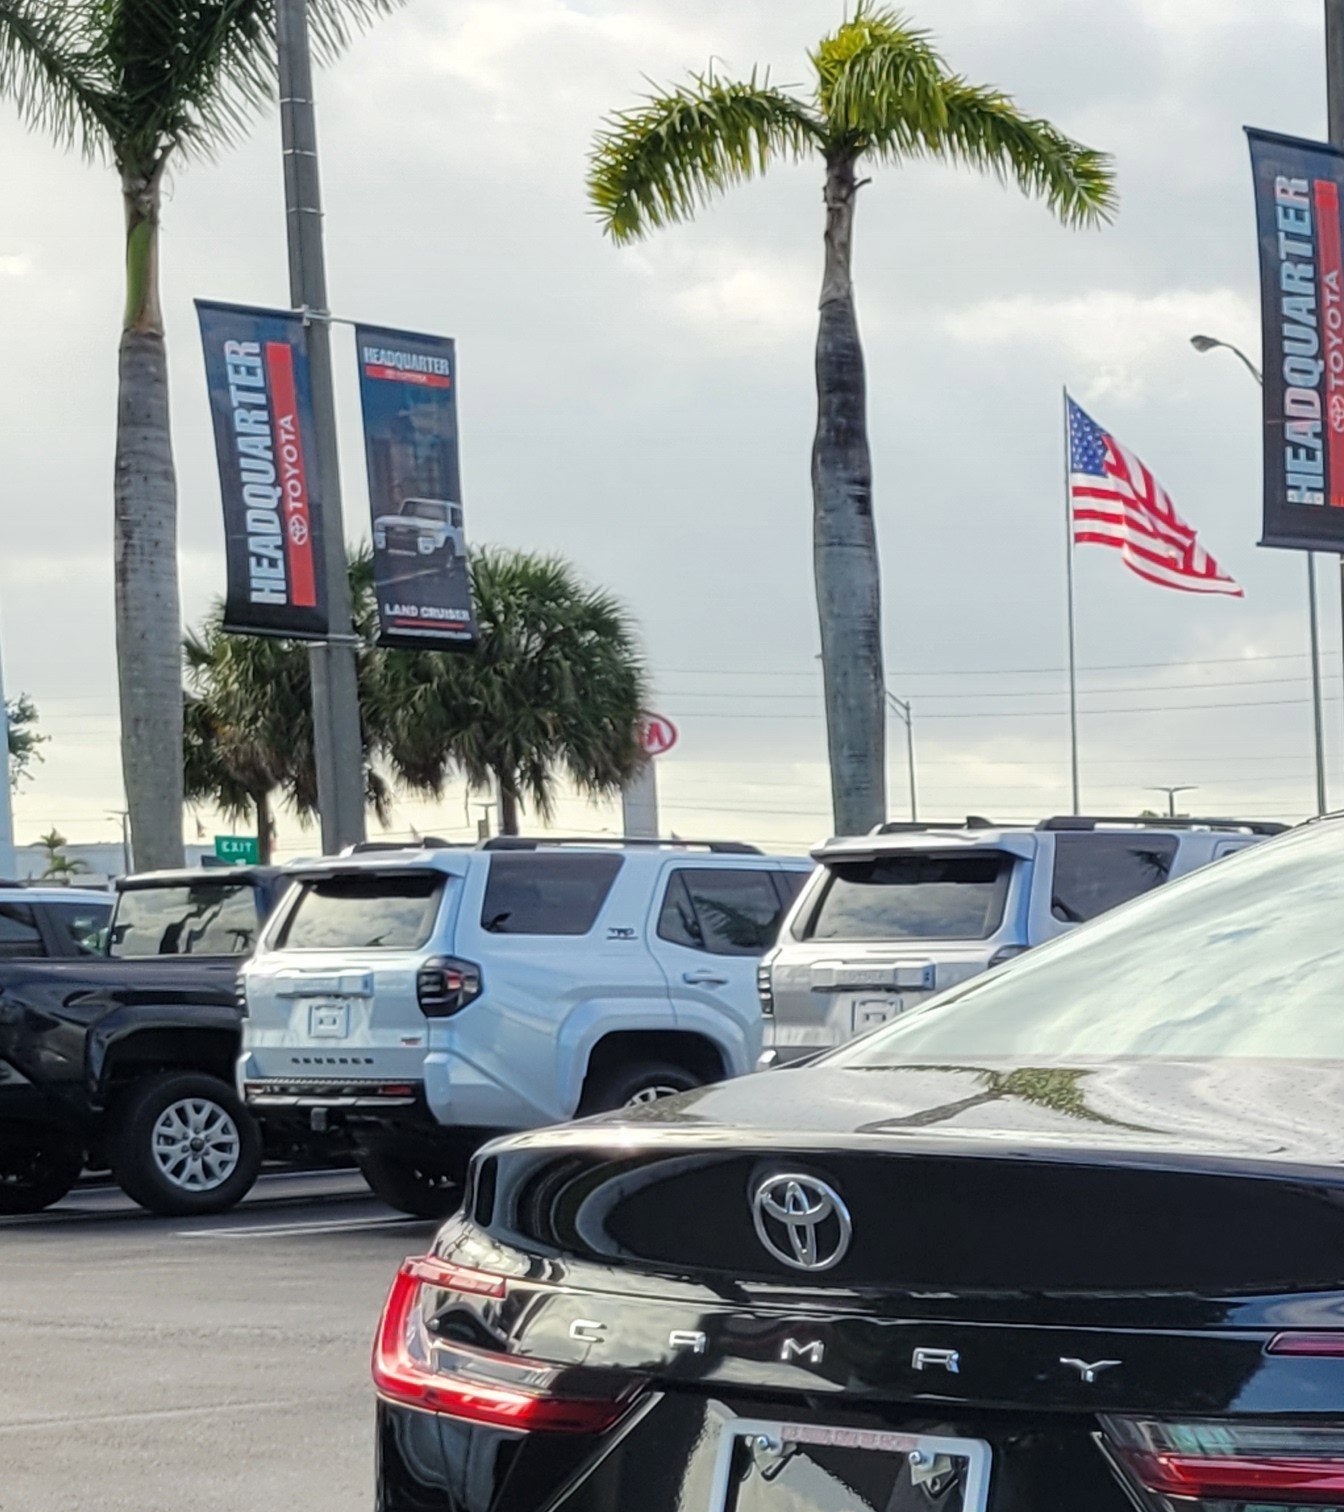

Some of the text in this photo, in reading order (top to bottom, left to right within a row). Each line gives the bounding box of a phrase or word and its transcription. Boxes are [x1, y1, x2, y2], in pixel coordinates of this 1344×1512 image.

[363, 346, 450, 376] HEADQUARTER
[1275, 175, 1325, 506] HEADQUARTER
[1324, 270, 1344, 391] TOYOTA
[224, 339, 287, 605] HEADQUARTER
[278, 414, 304, 511] TOYOTA
[384, 603, 470, 621] LAND CRUISER
[221, 841, 252, 853] EXIT
[568, 1318, 1123, 1383] CAMRY
